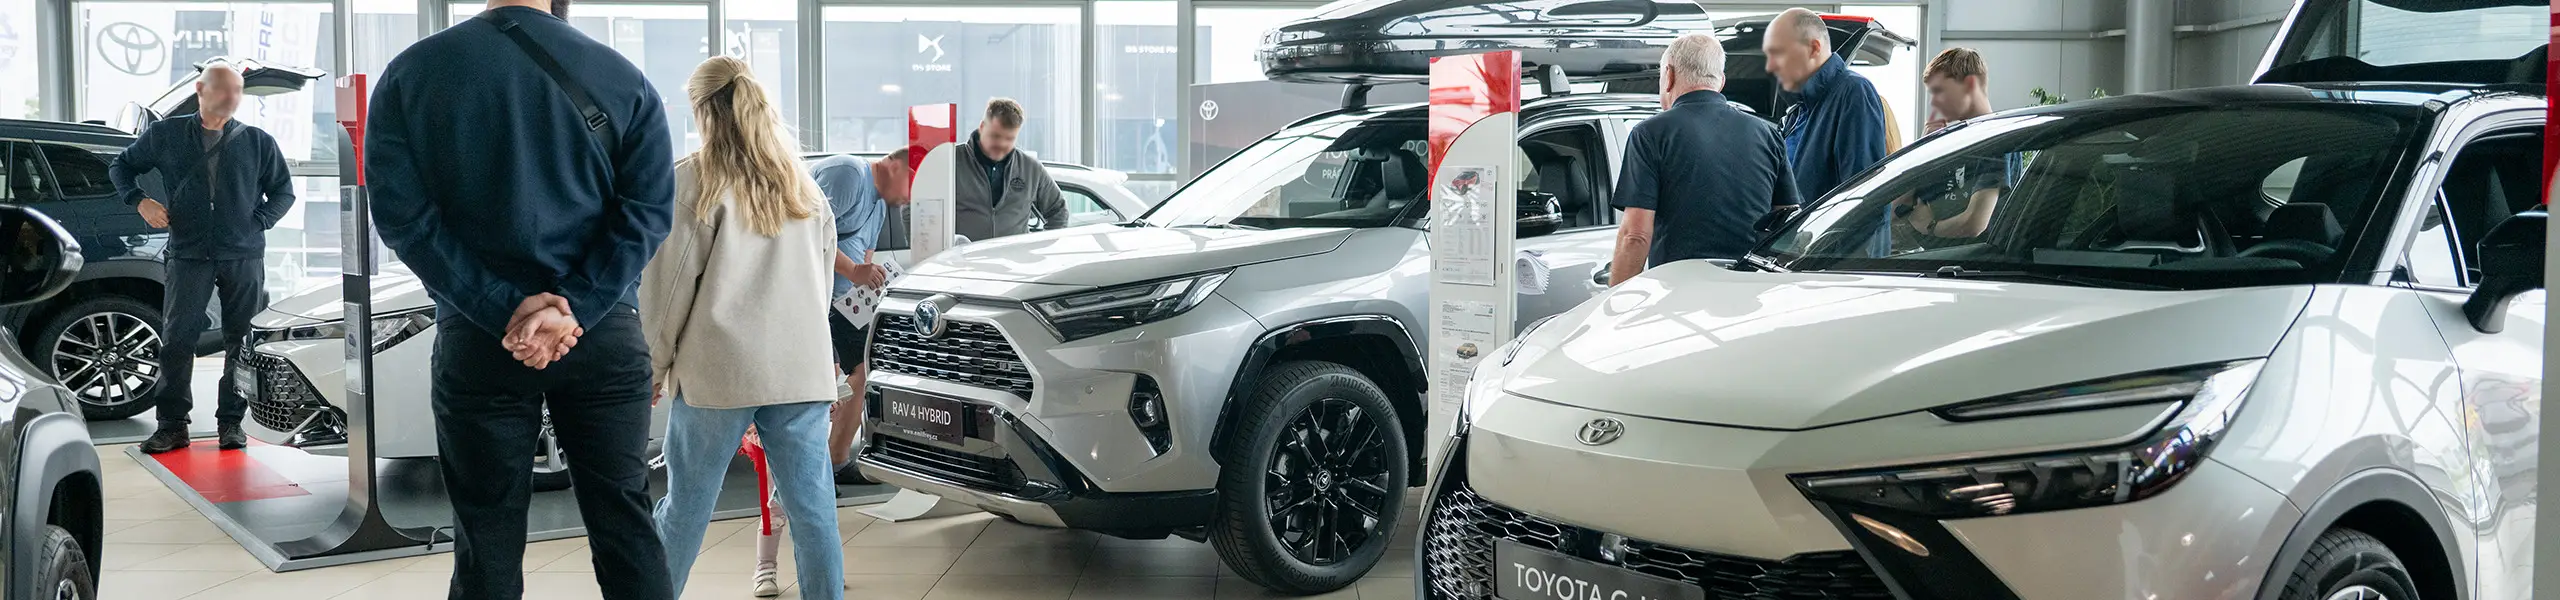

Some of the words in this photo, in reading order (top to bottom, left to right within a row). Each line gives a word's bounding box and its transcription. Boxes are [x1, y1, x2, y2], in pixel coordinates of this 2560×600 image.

[892, 401, 909, 417] RAV
[910, 405, 916, 418] 4
[918, 406, 951, 426] HYBRID
[1329, 375, 1395, 422] BRIDGESTONE
[1514, 562, 1600, 600] TOYOTA
